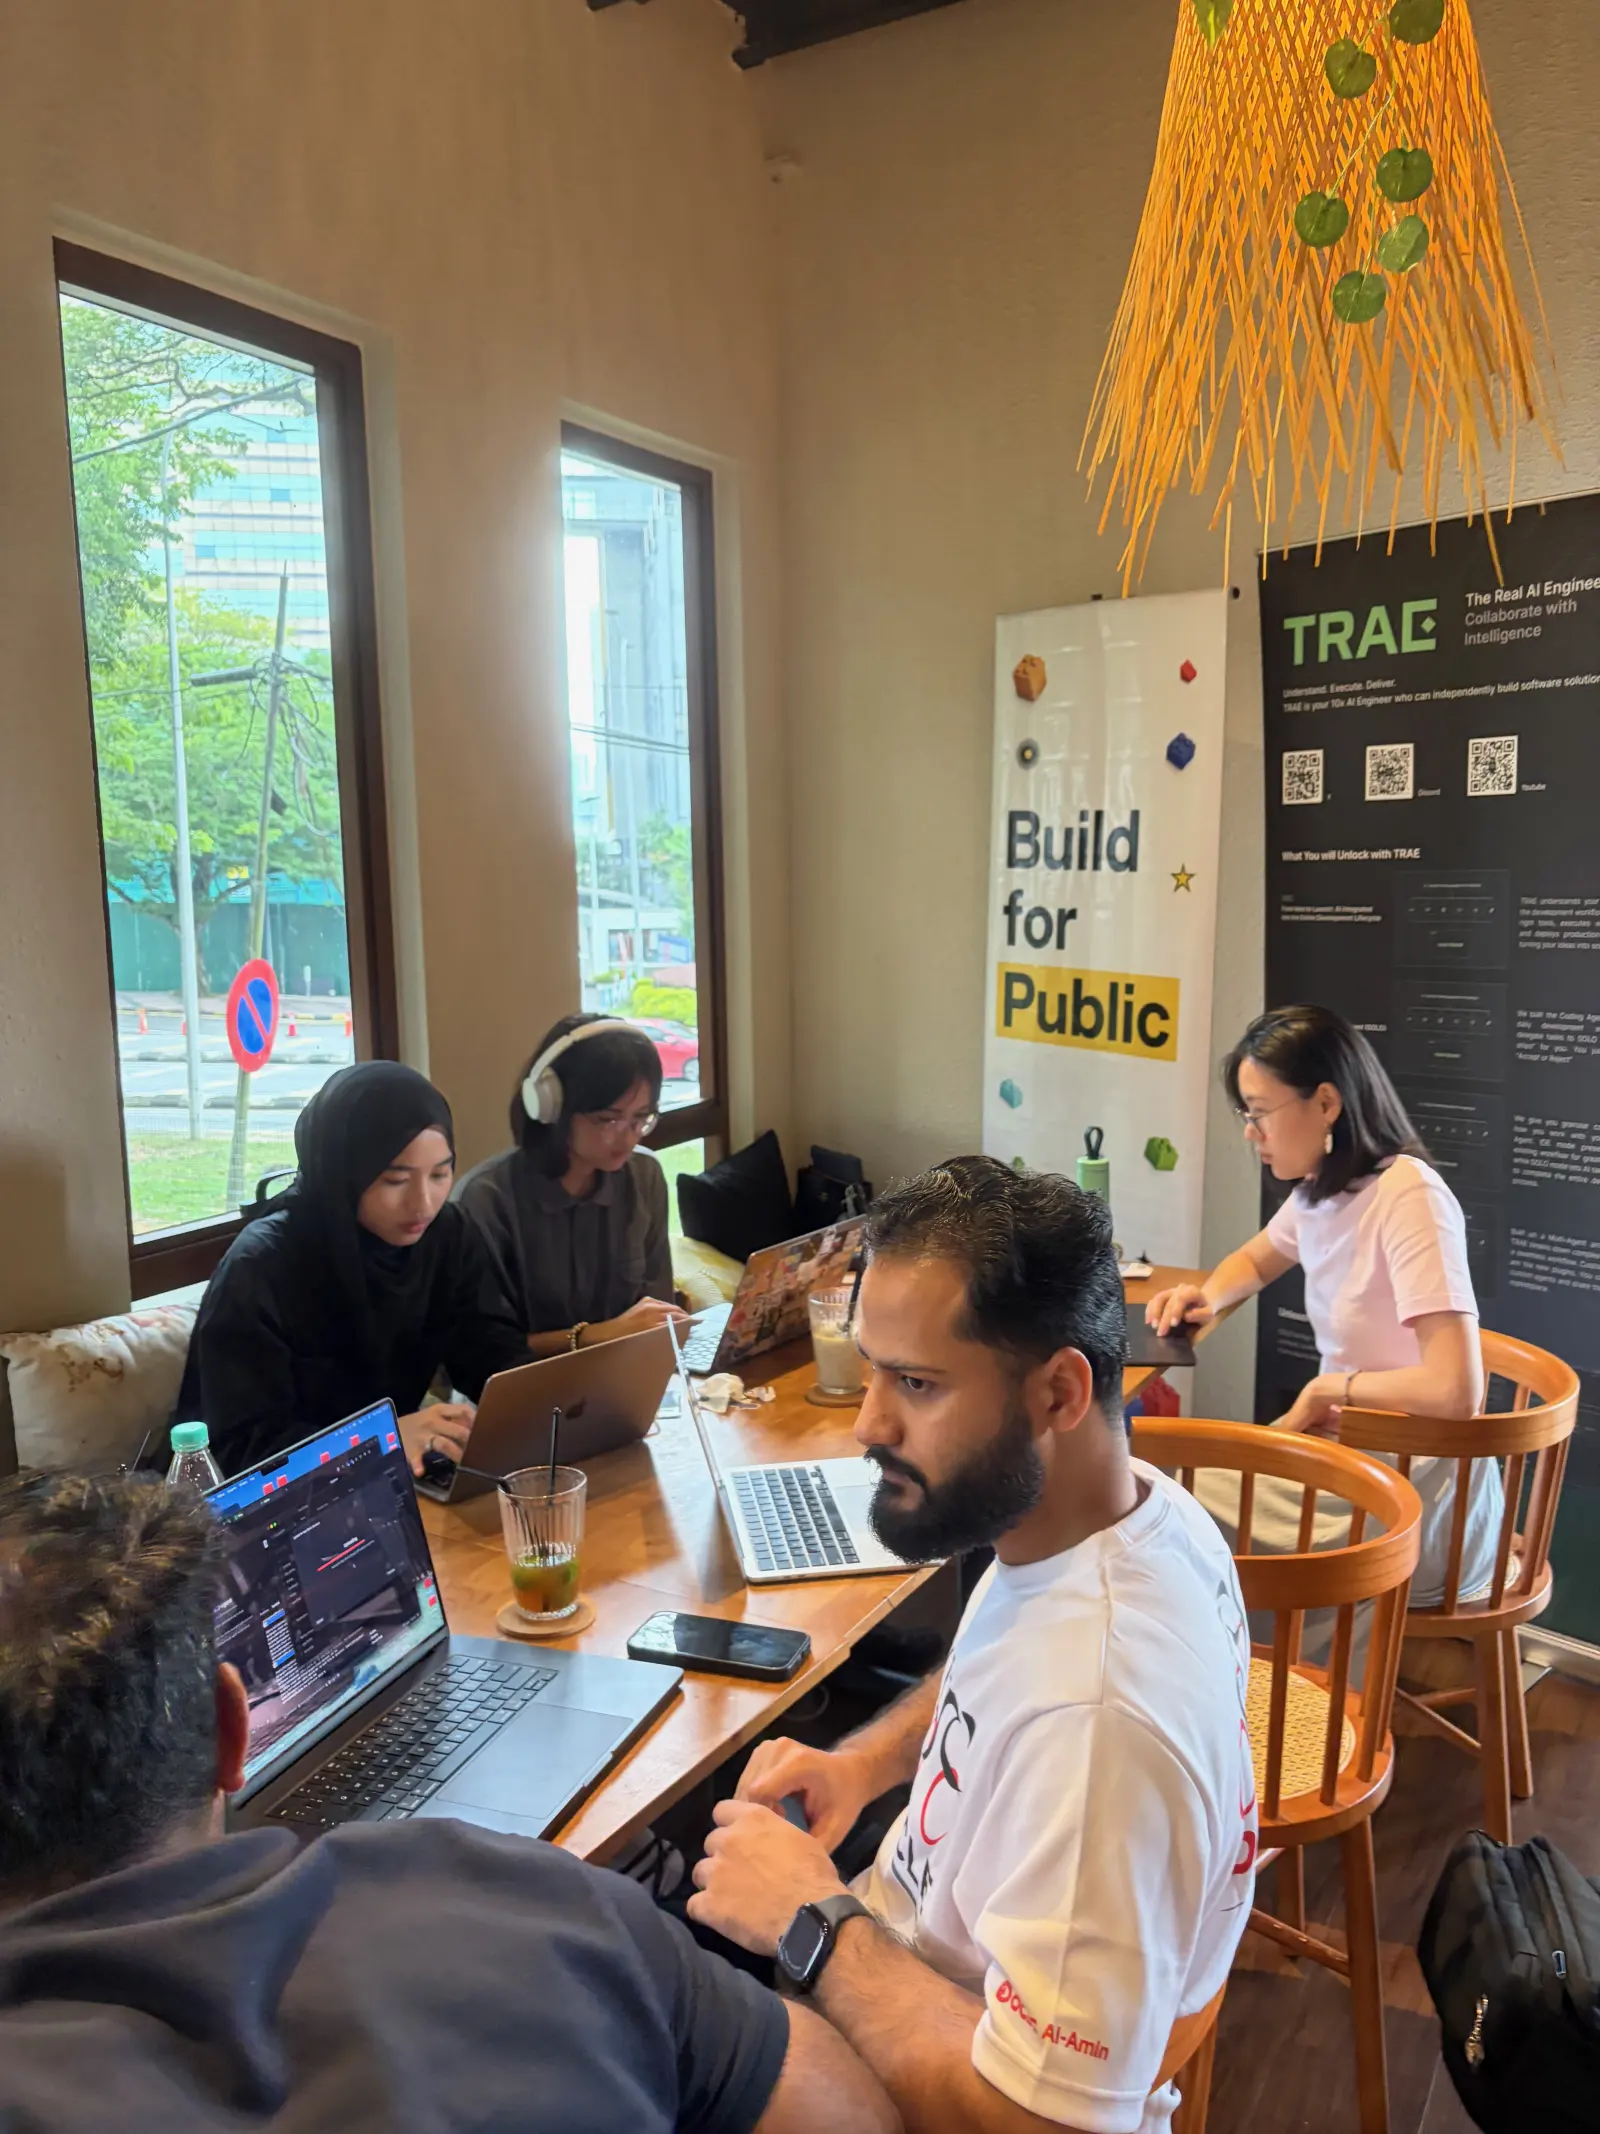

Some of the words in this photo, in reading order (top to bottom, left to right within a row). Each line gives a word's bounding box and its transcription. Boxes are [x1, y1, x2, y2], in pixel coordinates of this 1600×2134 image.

[1465, 592, 1491, 607] The
[1494, 585, 1524, 603] Real
[1526, 582, 1541, 598] AI
[1465, 604, 1543, 627] Collaborate
[1546, 598, 1578, 615] with
[1284, 598, 1437, 666] TRAE
[1464, 625, 1542, 646] Intelligence
[1356, 694, 1393, 707] Engineer
[1394, 693, 1413, 703] who
[1414, 691, 1431, 701] can
[1432, 684, 1496, 700] independently
[1497, 680, 1519, 694] build
[1520, 677, 1562, 692] software
[1365, 679, 1397, 690] Deliver.
[1006, 809, 1140, 873] Build
[1282, 851, 1303, 862] What
[1303, 851, 1320, 861] You
[1321, 850, 1336, 861] will
[1337, 849, 1370, 861] Unlock
[1371, 848, 1392, 860] with
[1393, 847, 1421, 859] TRAE
[1003, 888, 1077, 951] for
[1003, 971, 1171, 1049] Public
[1042, 2023, 1110, 2061] Al-Amin
